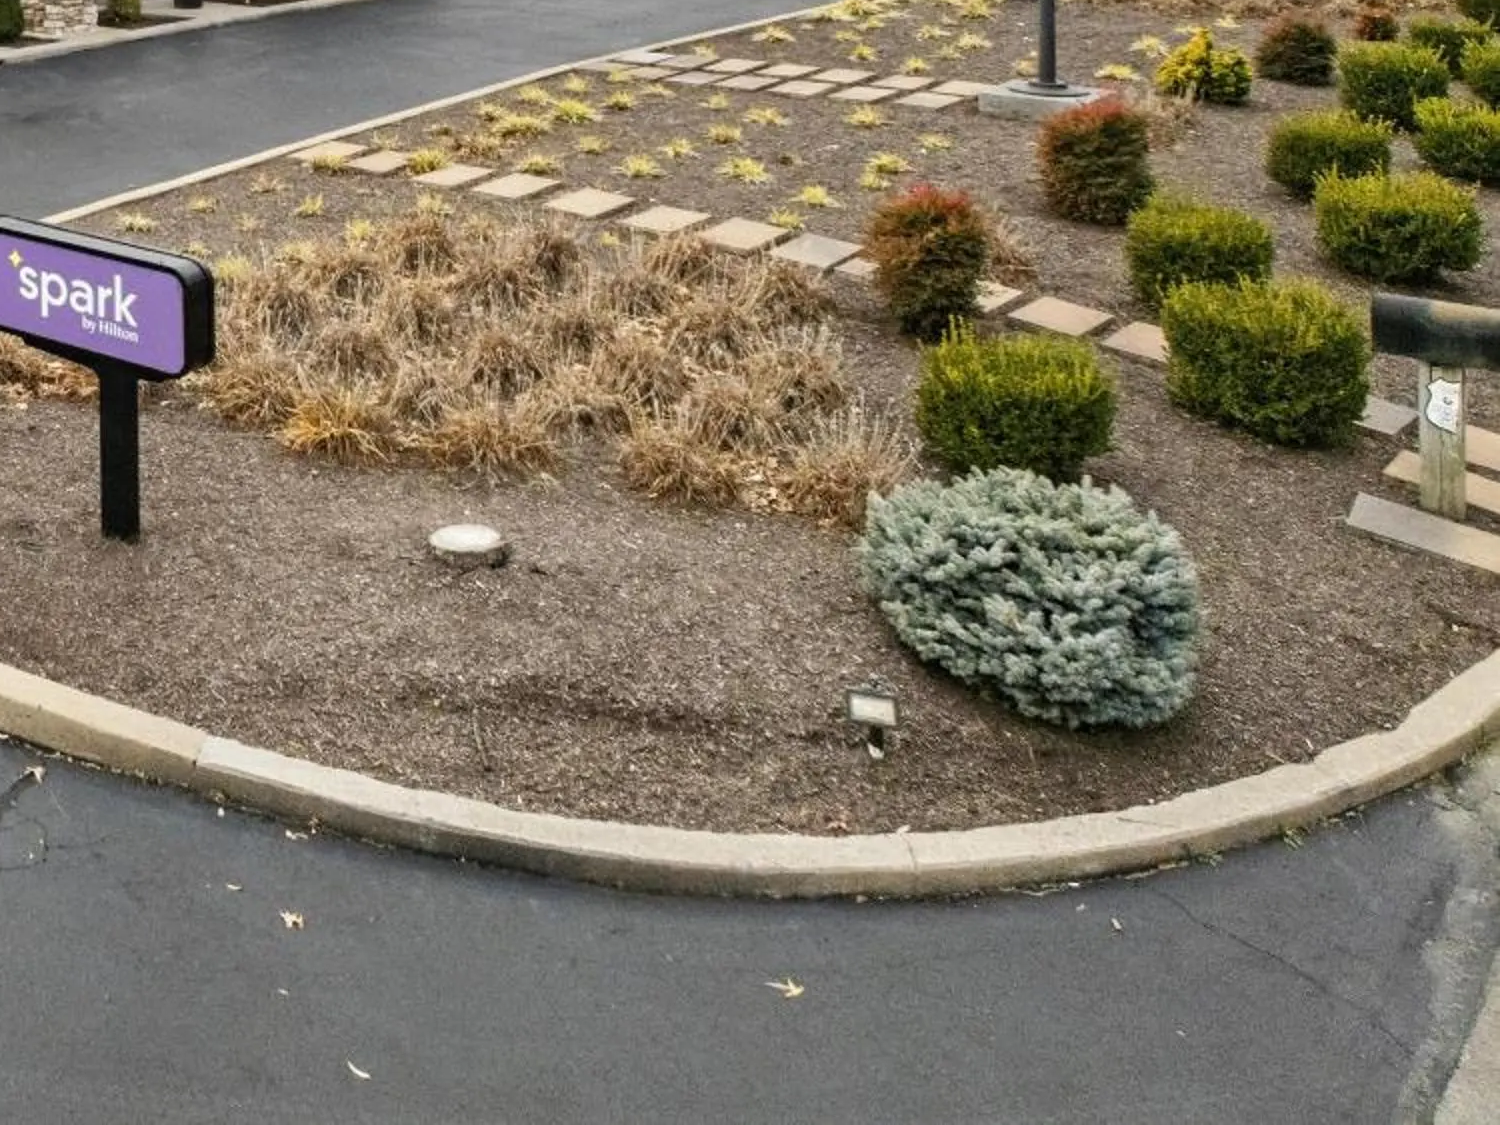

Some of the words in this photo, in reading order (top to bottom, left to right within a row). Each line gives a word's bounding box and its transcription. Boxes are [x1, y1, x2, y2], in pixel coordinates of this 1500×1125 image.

[19, 266, 138, 327] spark
[81, 315, 97, 334] by
[99, 320, 139, 342] Hilton
